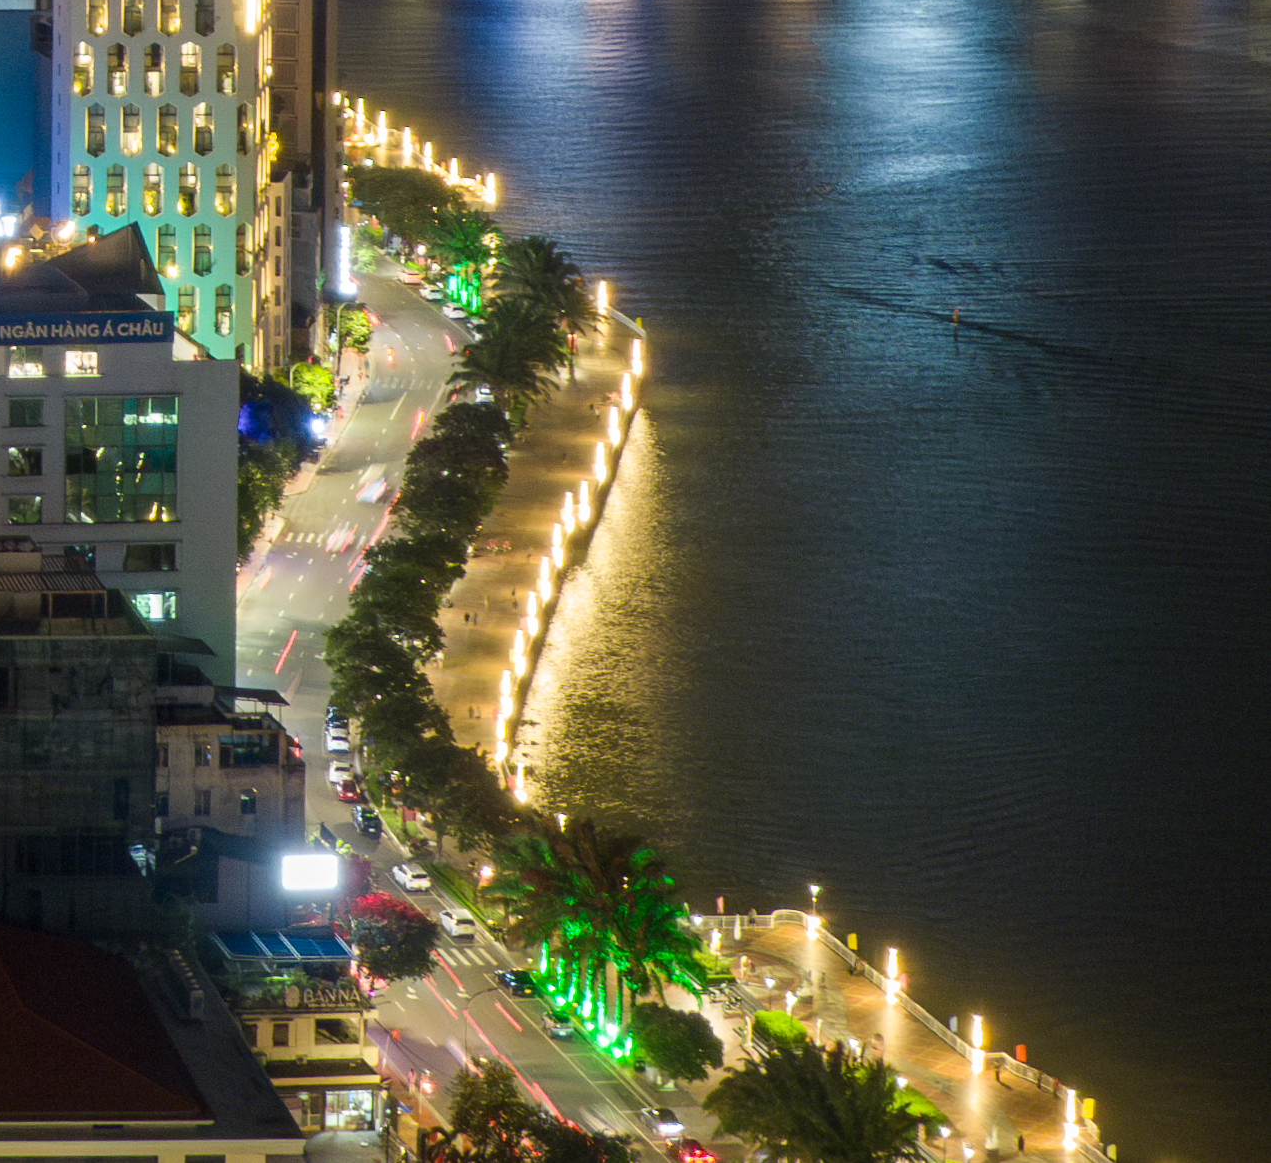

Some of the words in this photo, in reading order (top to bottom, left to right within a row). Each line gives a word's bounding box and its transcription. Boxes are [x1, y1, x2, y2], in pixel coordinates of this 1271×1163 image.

[0, 321, 48, 339] NGÂN
[51, 320, 100, 338] HÀNG
[103, 319, 115, 337] Á
[117, 318, 164, 336] CHÂU
